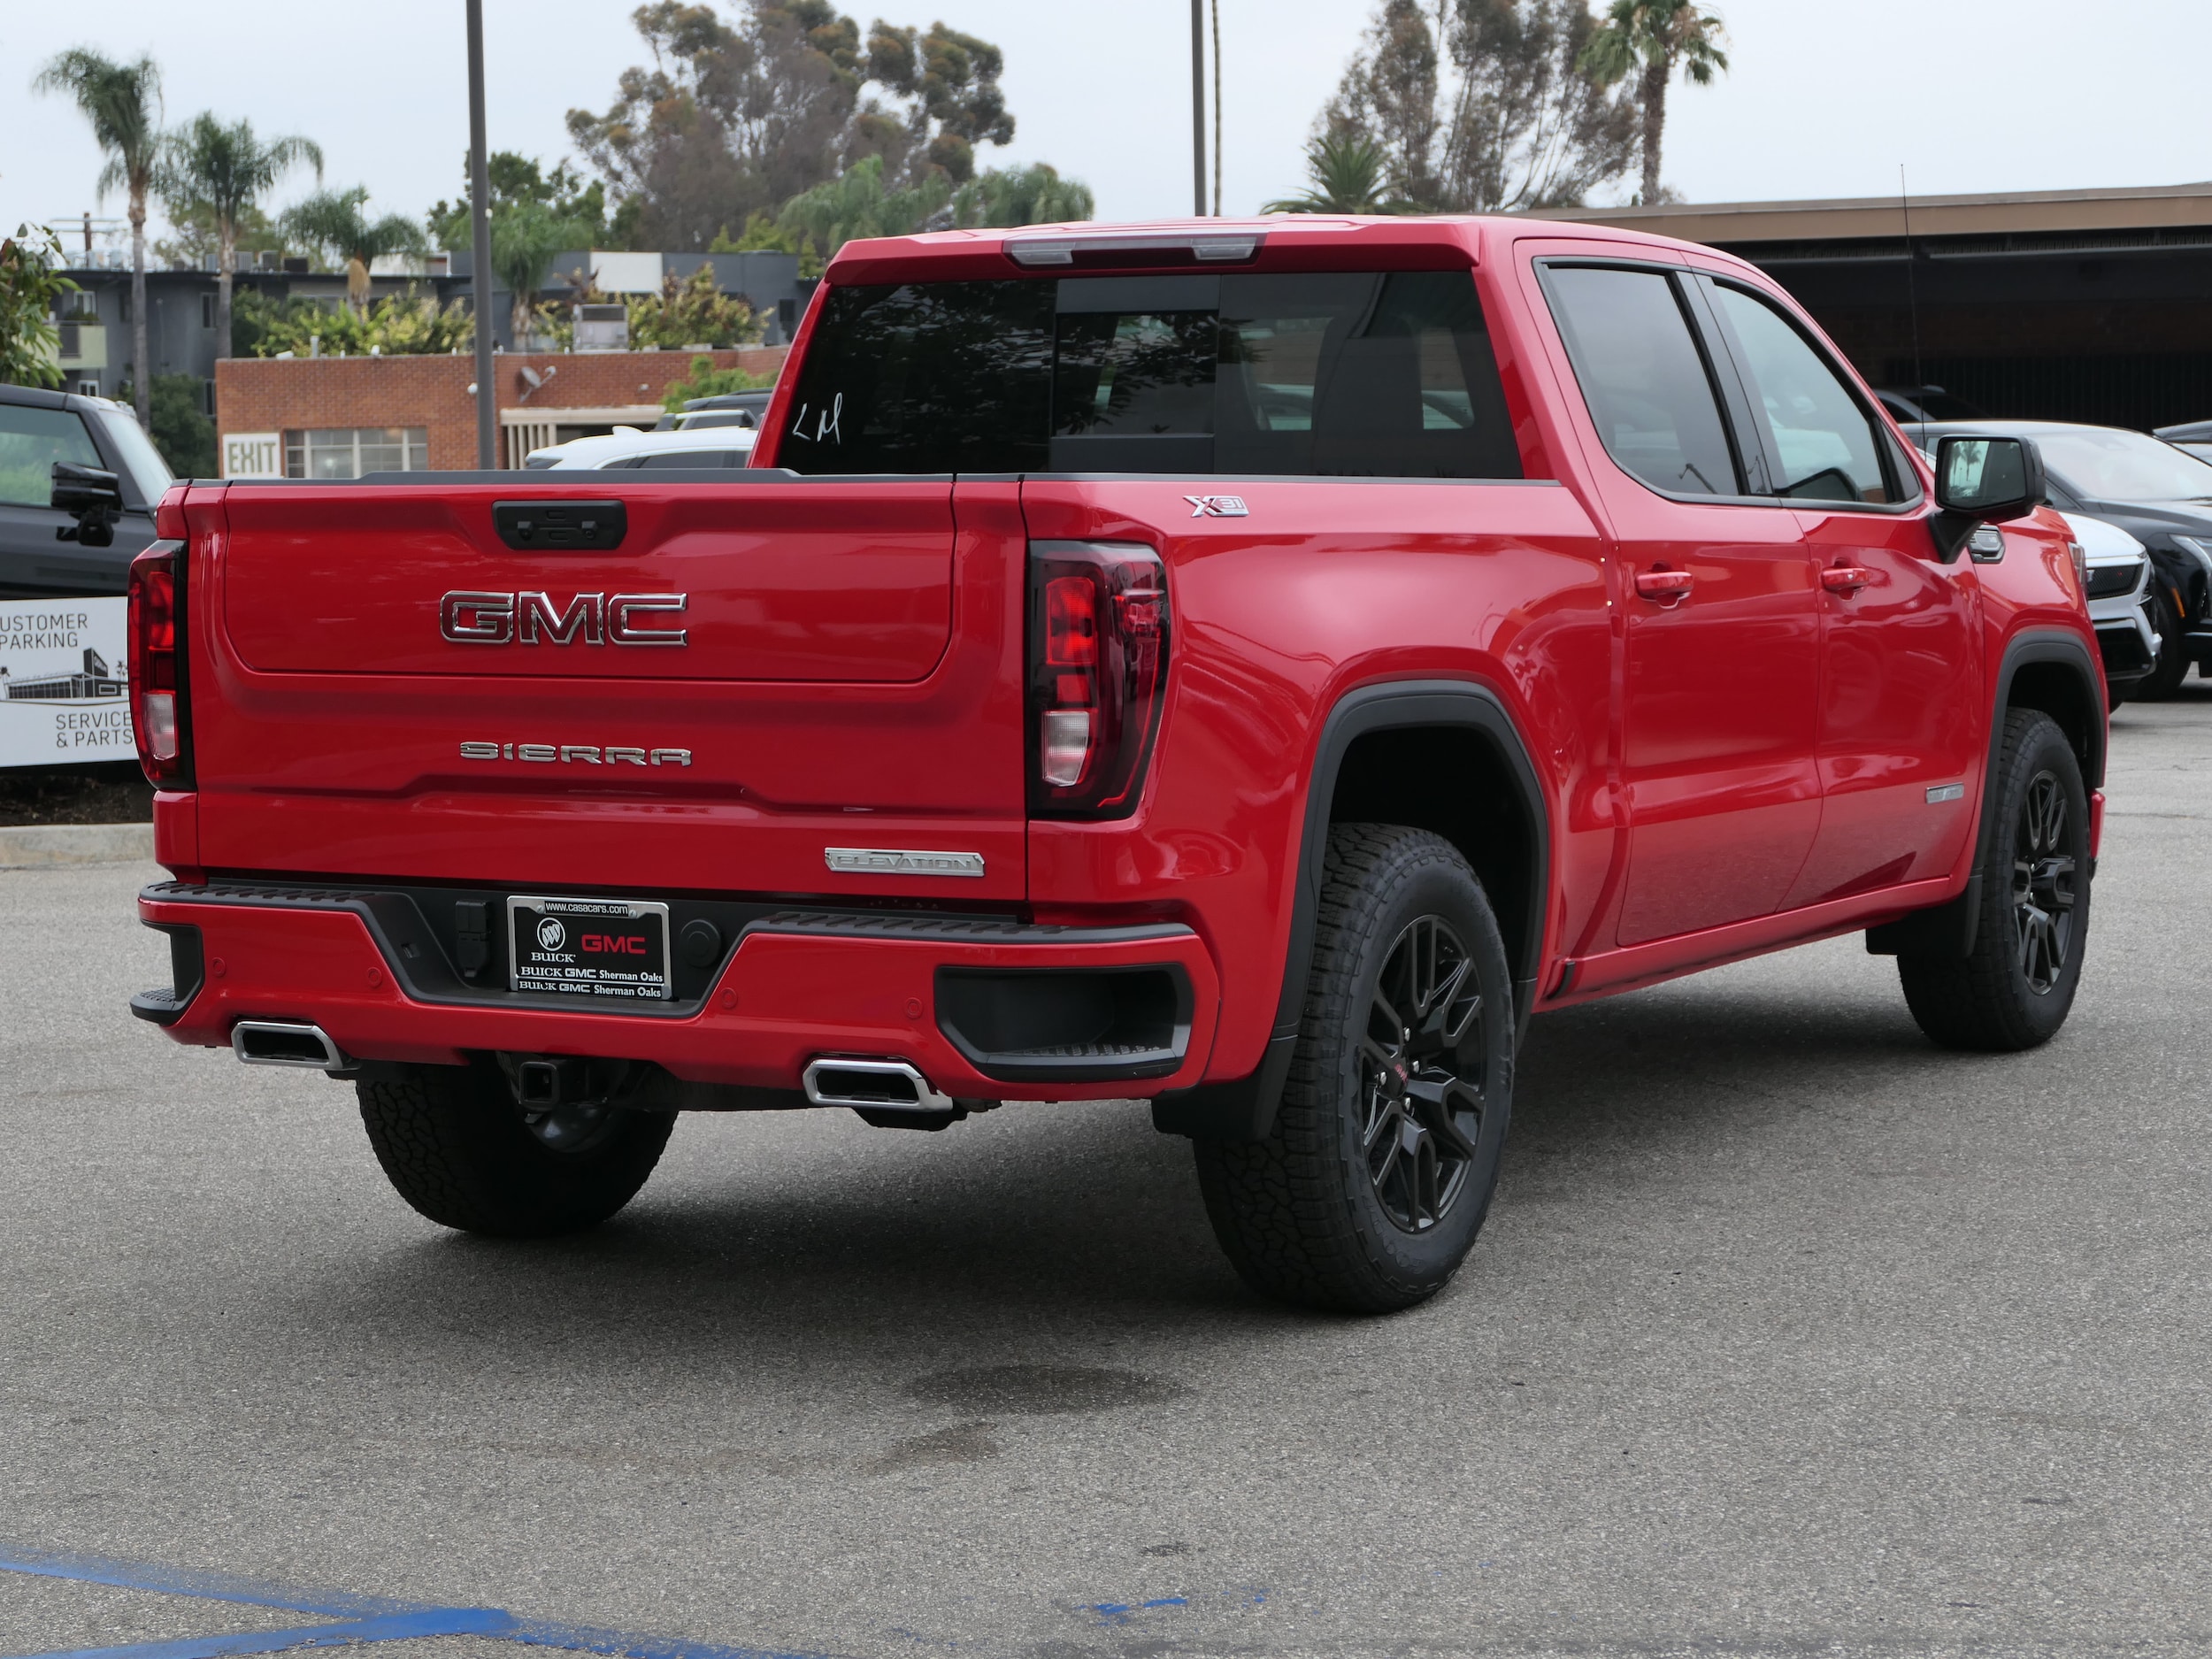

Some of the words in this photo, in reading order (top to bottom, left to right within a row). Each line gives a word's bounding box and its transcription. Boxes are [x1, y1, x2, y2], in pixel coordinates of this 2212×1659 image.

[227, 442, 276, 473] EXIT
[1182, 495, 1249, 518] X31
[0, 613, 88, 632] USTOMER
[439, 590, 687, 647] GMC
[0, 632, 78, 650] PARKING
[56, 710, 133, 730] SERVICE
[57, 732, 68, 749] &
[75, 728, 133, 748] PARTS
[460, 741, 692, 766] SIERRA
[837, 854, 972, 869] ELEVATION
[545, 902, 628, 915] www.casacars.com
[580, 933, 647, 955] GMC
[531, 952, 575, 963] BUICK
[520, 966, 563, 978] BUICK
[565, 968, 596, 979] GMC
[599, 970, 638, 981] Sherman
[640, 972, 664, 983] Oaks
[519, 980, 557, 991] BUICK
[559, 983, 590, 993] GMC
[594, 985, 634, 996] Sherman
[637, 986, 661, 998] Oaks
